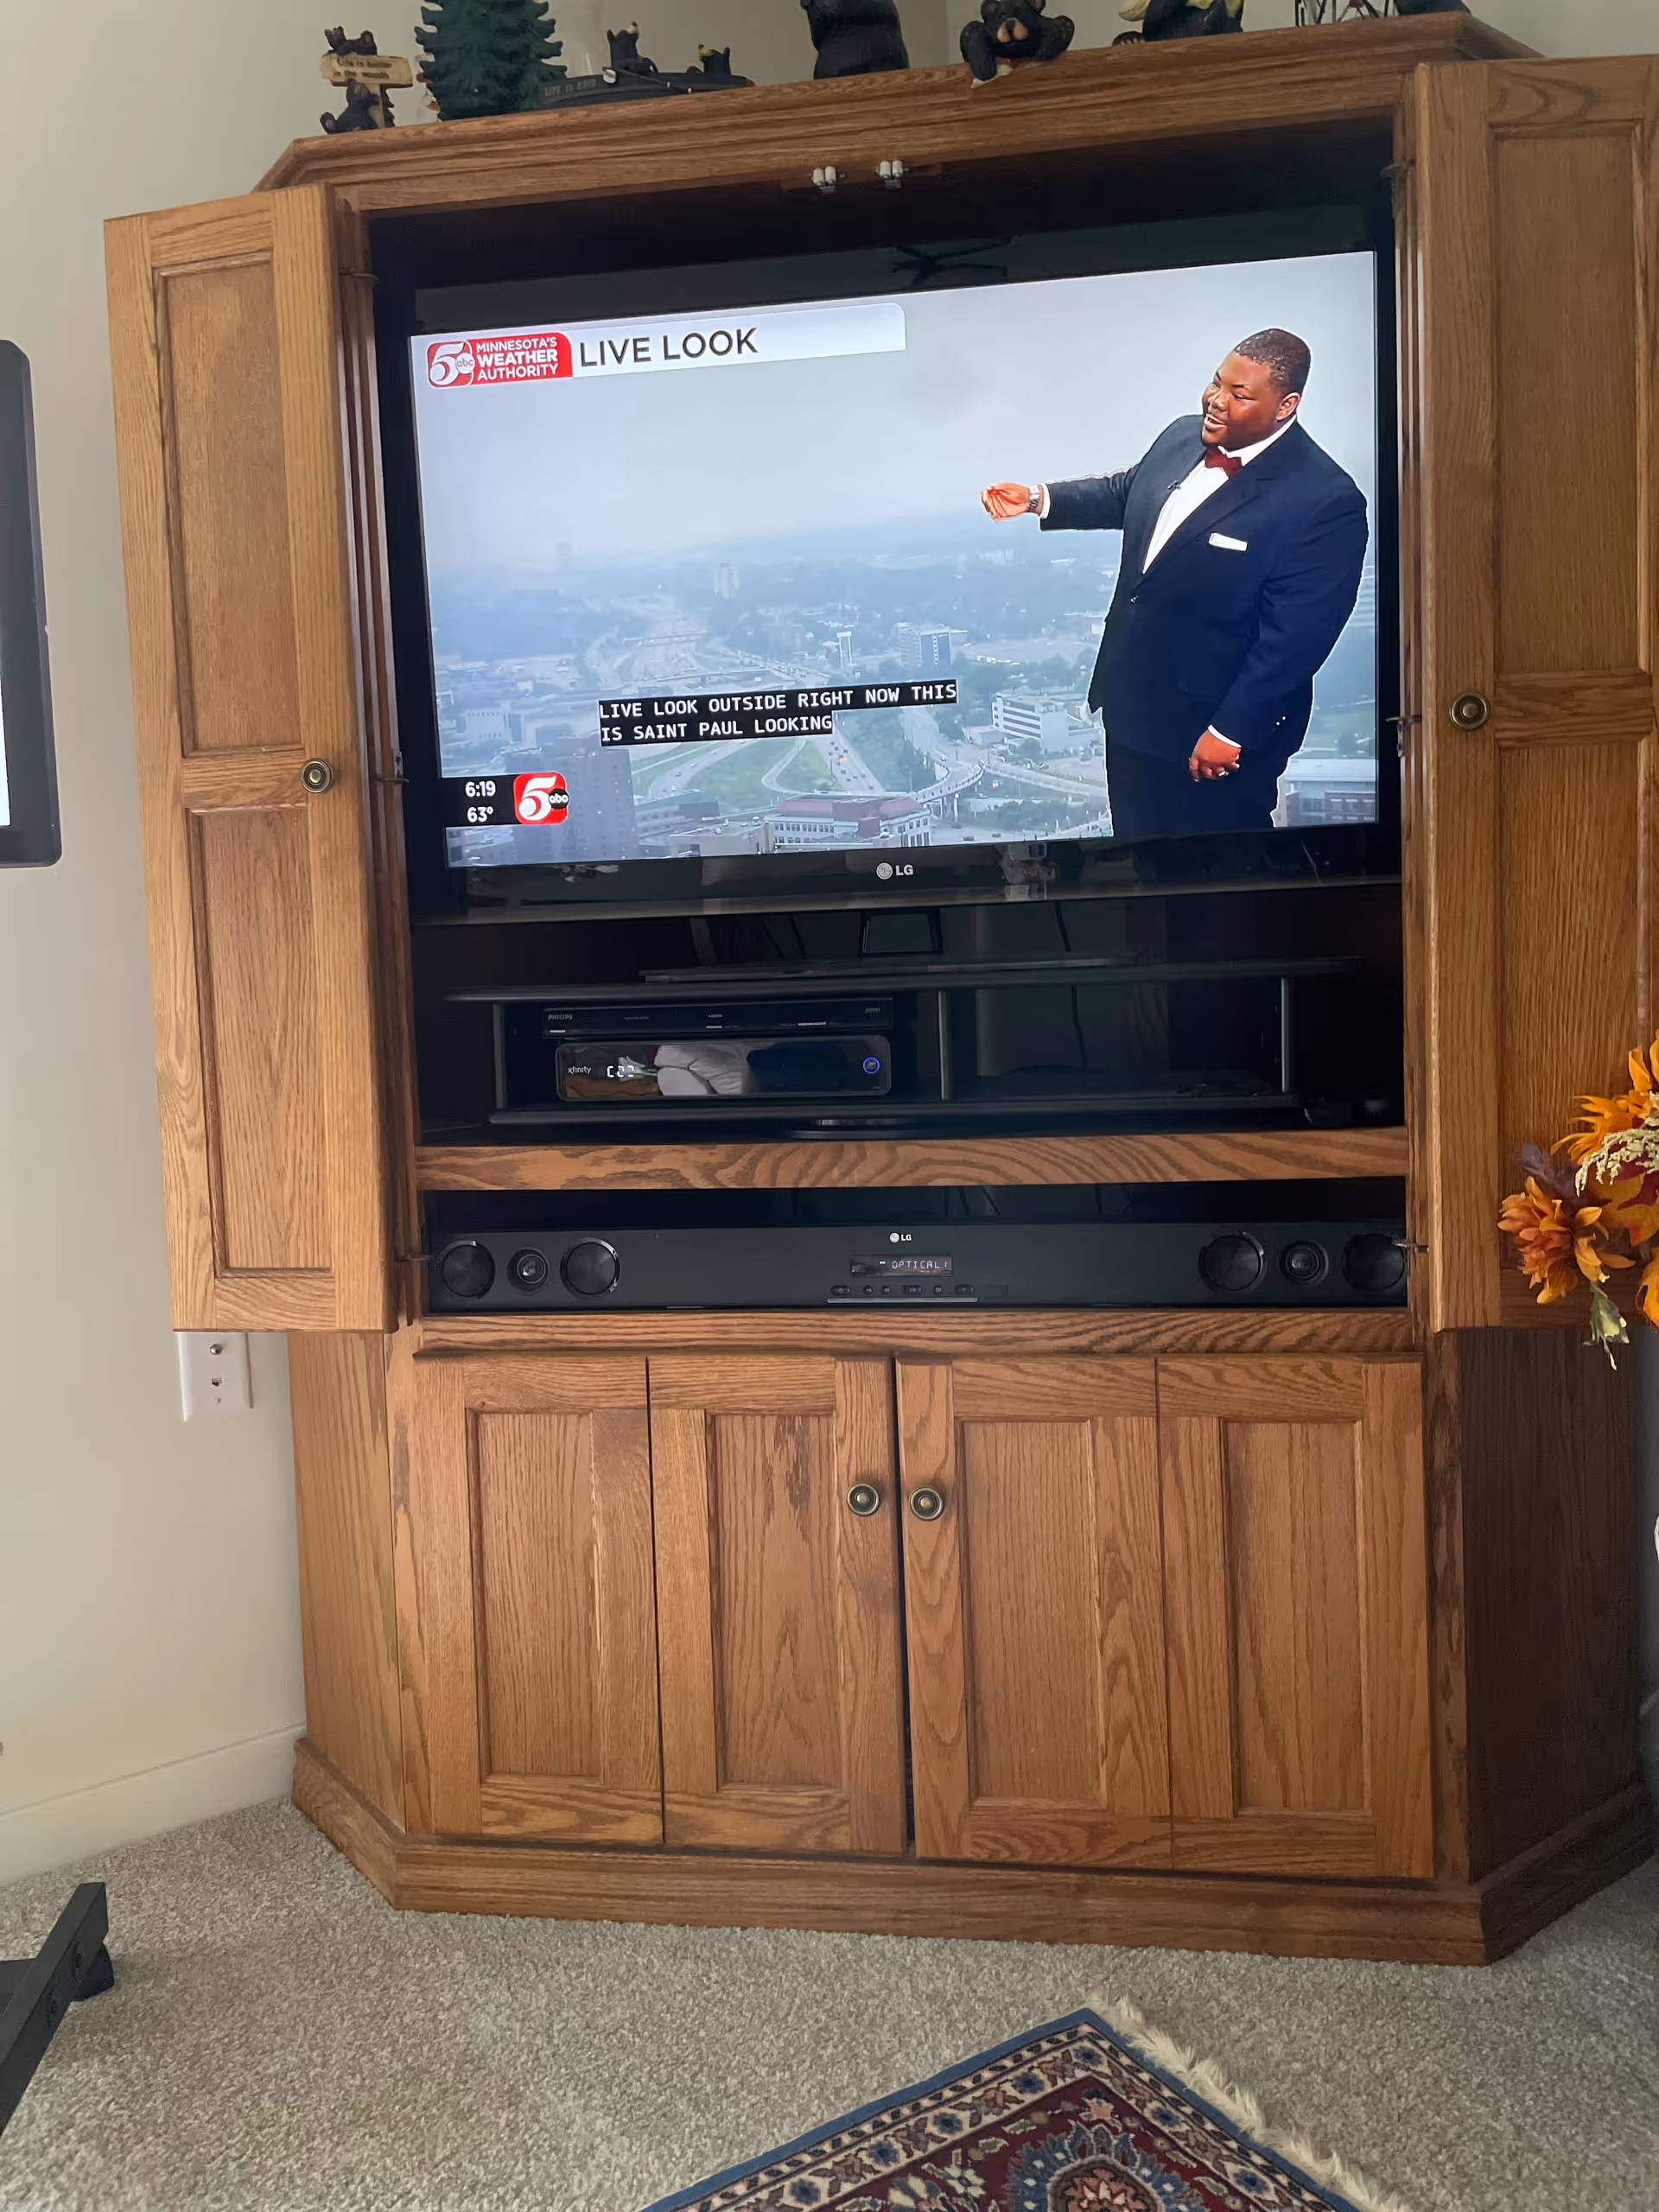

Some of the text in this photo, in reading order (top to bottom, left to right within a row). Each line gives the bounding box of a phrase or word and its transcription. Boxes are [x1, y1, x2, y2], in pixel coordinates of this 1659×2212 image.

[476, 336, 557, 353] MINNESOTA'S
[580, 327, 759, 367] LIVE LOOK
[457, 354, 474, 367] abc
[477, 348, 558, 368] WEATHER
[477, 363, 559, 381] AUTHORITY
[600, 683, 957, 719] LIVE LOOK OUTSIDE RIGHT NOW THIS
[601, 715, 832, 741] IS SAINT PAUL LOOKING
[465, 780, 497, 798] 6:19
[518, 775, 556, 821] 5
[549, 793, 569, 804] abc
[895, 864, 914, 876] LG
[568, 1065, 592, 1075] xfinity
